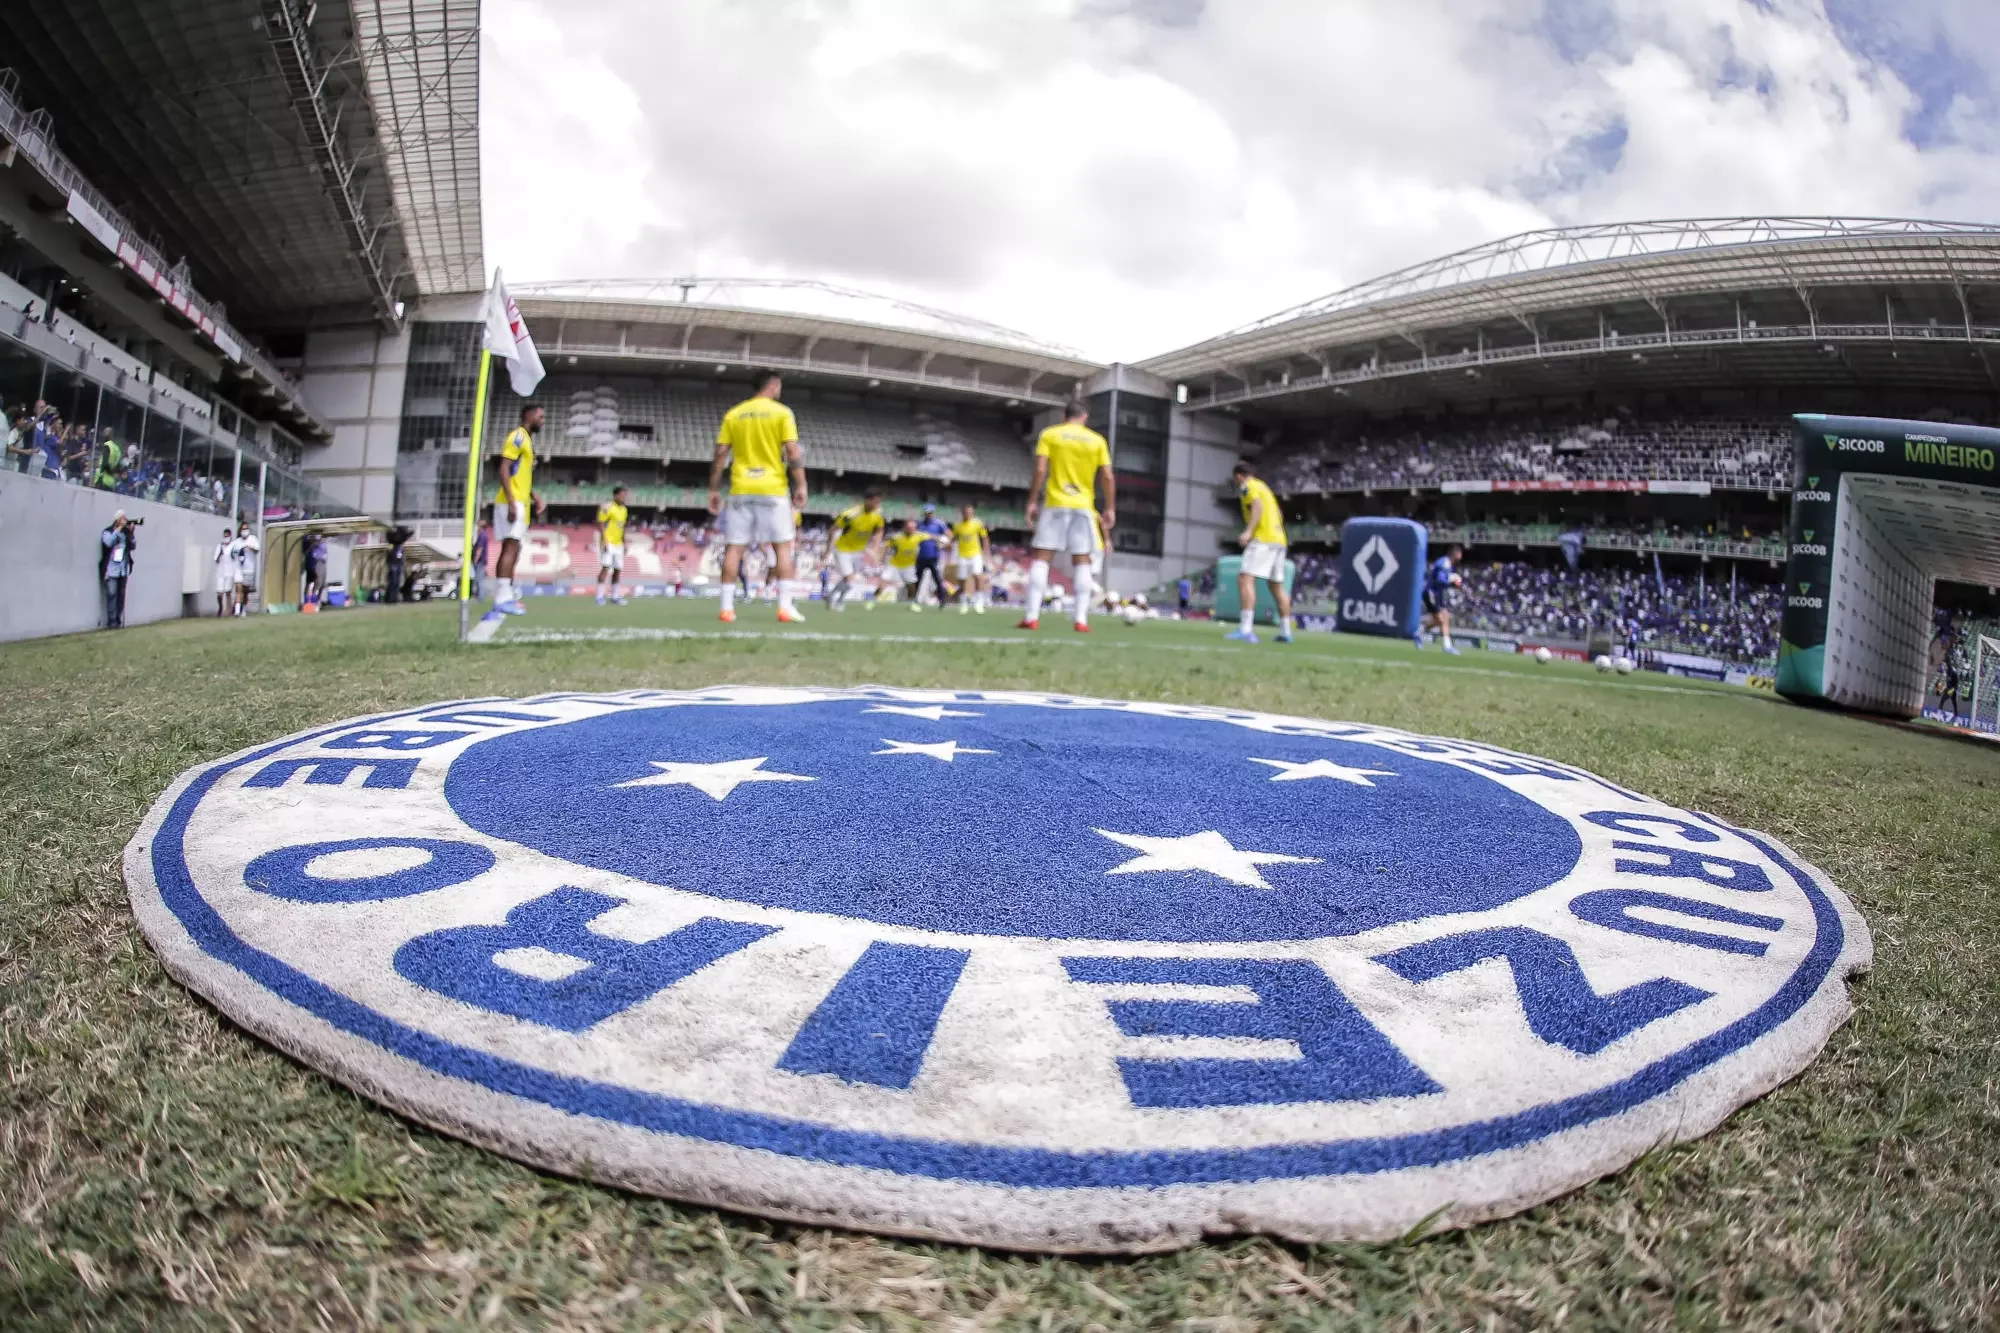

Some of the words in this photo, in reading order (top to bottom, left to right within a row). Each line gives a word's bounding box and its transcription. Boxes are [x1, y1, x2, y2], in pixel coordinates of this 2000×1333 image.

[1838, 437, 1885, 453] SICOOB
[1904, 441, 1995, 472] MINEIRO
[1796, 490, 1831, 502] SICOOB
[1792, 543, 1827, 556] SICOOB
[1788, 595, 1822, 609] SICOOB
[1342, 598, 1398, 628] CABAL
[242, 808, 1786, 1109] CRUZEIRO
